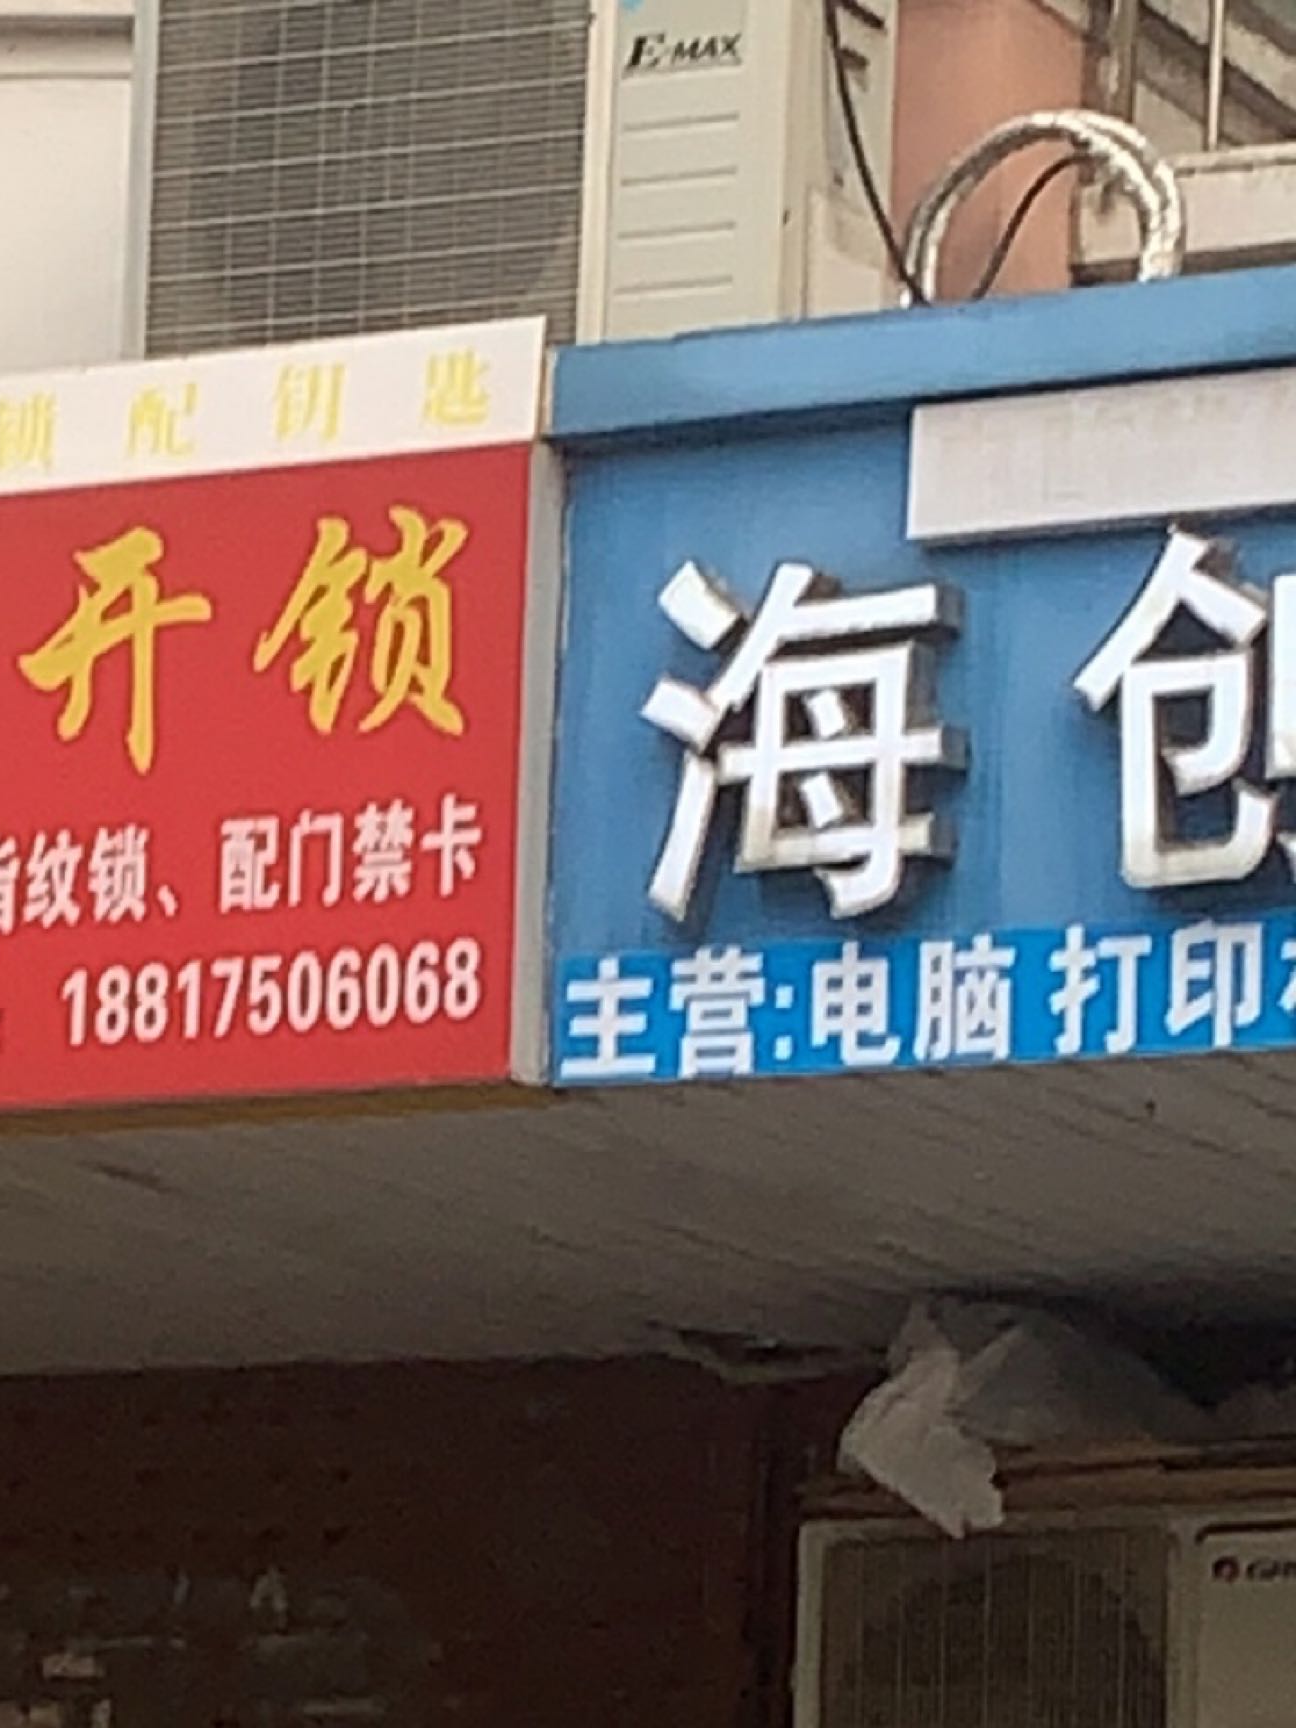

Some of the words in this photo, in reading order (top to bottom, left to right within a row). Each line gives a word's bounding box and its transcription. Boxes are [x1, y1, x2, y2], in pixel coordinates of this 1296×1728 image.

[640, 520, 1296, 922] 海创
[62, 938, 480, 1047] 18817506068
[559, 915, 1296, 1078] 主营:电脑打印
